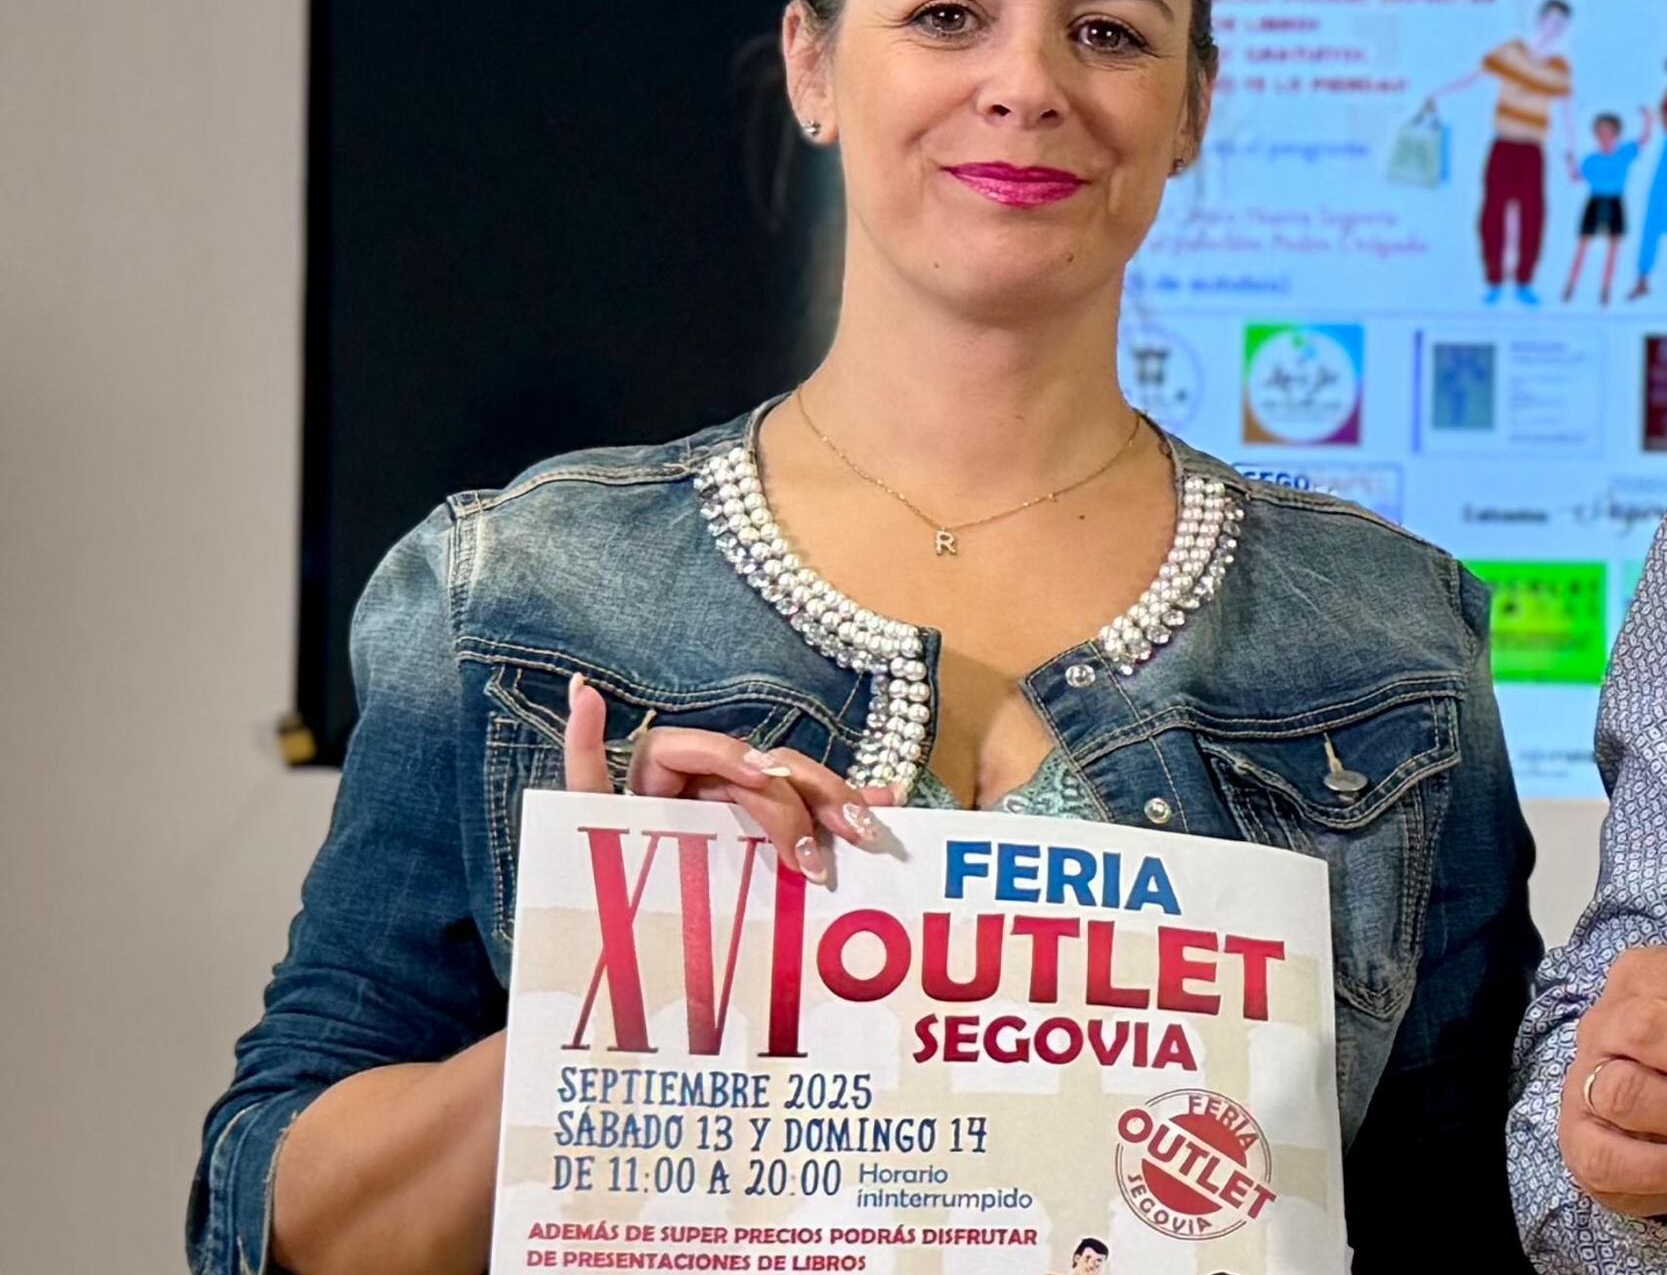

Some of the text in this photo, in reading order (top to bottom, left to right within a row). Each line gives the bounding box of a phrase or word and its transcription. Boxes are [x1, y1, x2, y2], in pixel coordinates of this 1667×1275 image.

[934, 528, 957, 556] R
[944, 840, 1182, 916] FERIA
[561, 826, 809, 1057] XVI
[815, 908, 1286, 1022] OUTLET
[912, 1013, 1197, 1071] SEGOVIA
[556, 1066, 872, 1110] SEPTIEMBRE 2025
[553, 1105, 987, 1153] SÁBADO 13 Y DOMINGO 14
[551, 1154, 841, 1196] DE 11:00 A 20:00
[858, 1162, 949, 1184] Horario
[527, 1219, 1038, 1246] ADEMÁS DE SUPER PRECIOS PODRÁS DISFRUTAR
[526, 1249, 866, 1272] DE PRESENTACIONES DE LIBROS
